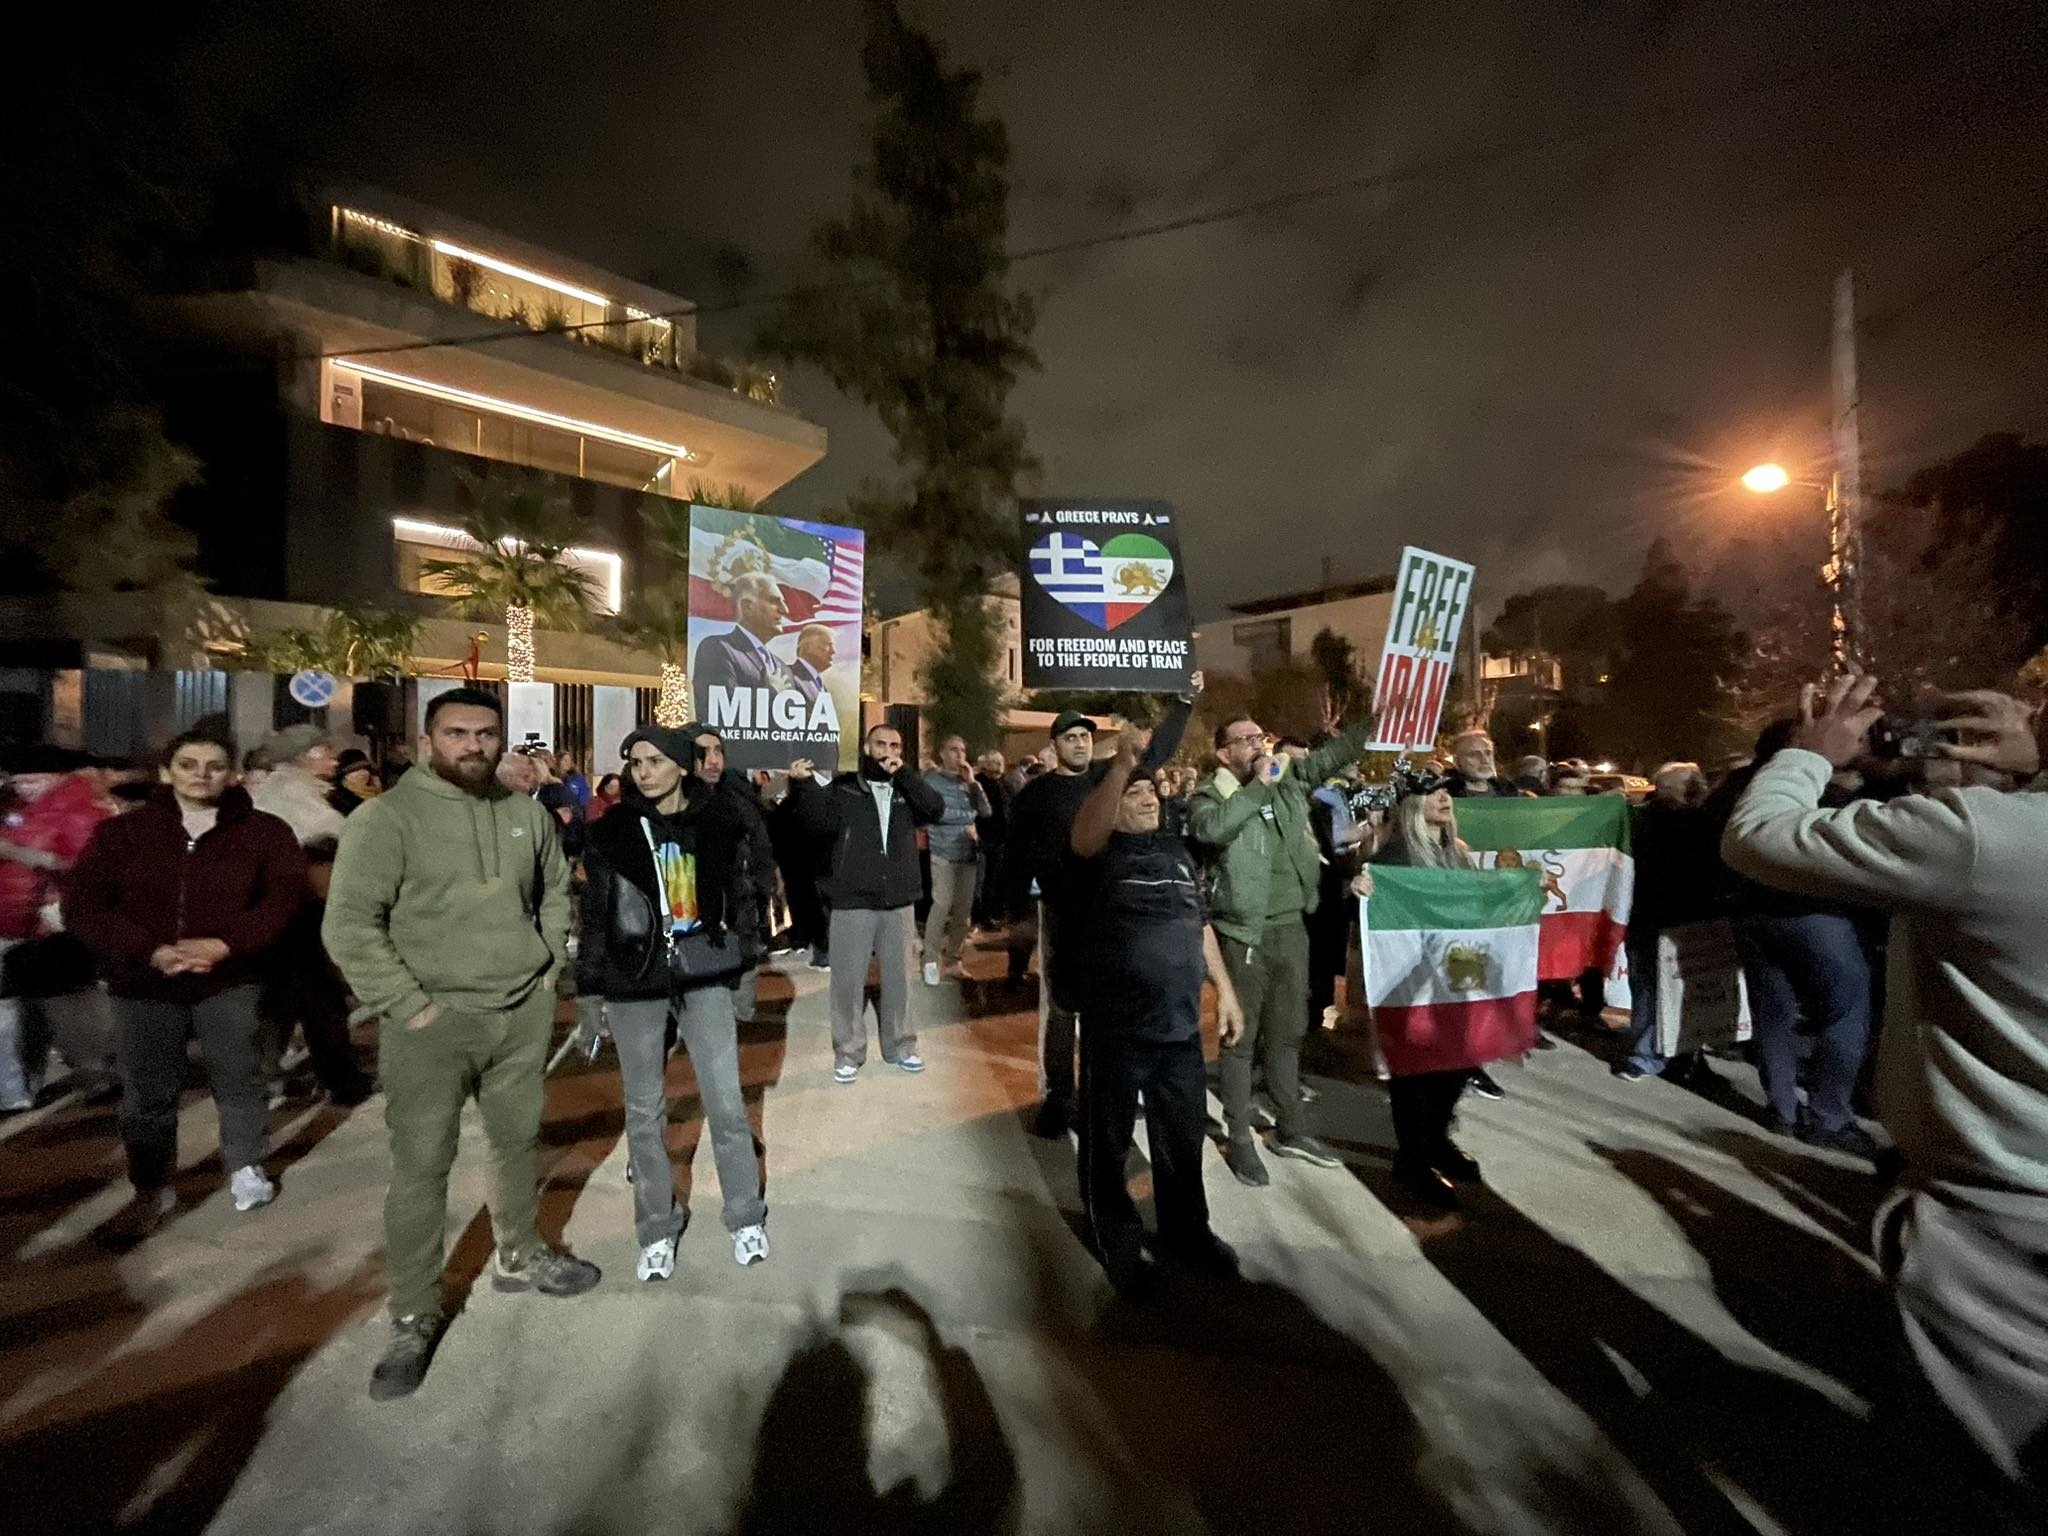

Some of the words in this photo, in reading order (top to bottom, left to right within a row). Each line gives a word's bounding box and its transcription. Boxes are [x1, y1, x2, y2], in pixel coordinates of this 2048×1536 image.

[1055, 510, 1100, 524] GREECE
[1101, 511, 1139, 524] PRAYS
[1391, 555, 1469, 652] FREE
[1029, 638, 1055, 652] FOR
[1057, 638, 1116, 653] FREEDOM
[1119, 639, 1146, 654] AND
[1148, 640, 1188, 655] PEACE
[1037, 653, 1056, 667] TO
[1056, 653, 1083, 667] THE
[1083, 653, 1130, 668] PEOPLE
[1131, 654, 1149, 668] OF
[1151, 654, 1183, 669] IRAN
[707, 684, 841, 731] MIGA
[1378, 653, 1449, 745] IRAN
[719, 728, 740, 740] AKE
[743, 730, 769, 741] IRAN
[771, 730, 805, 742] GREAT
[806, 732, 840, 743] AGAIN
